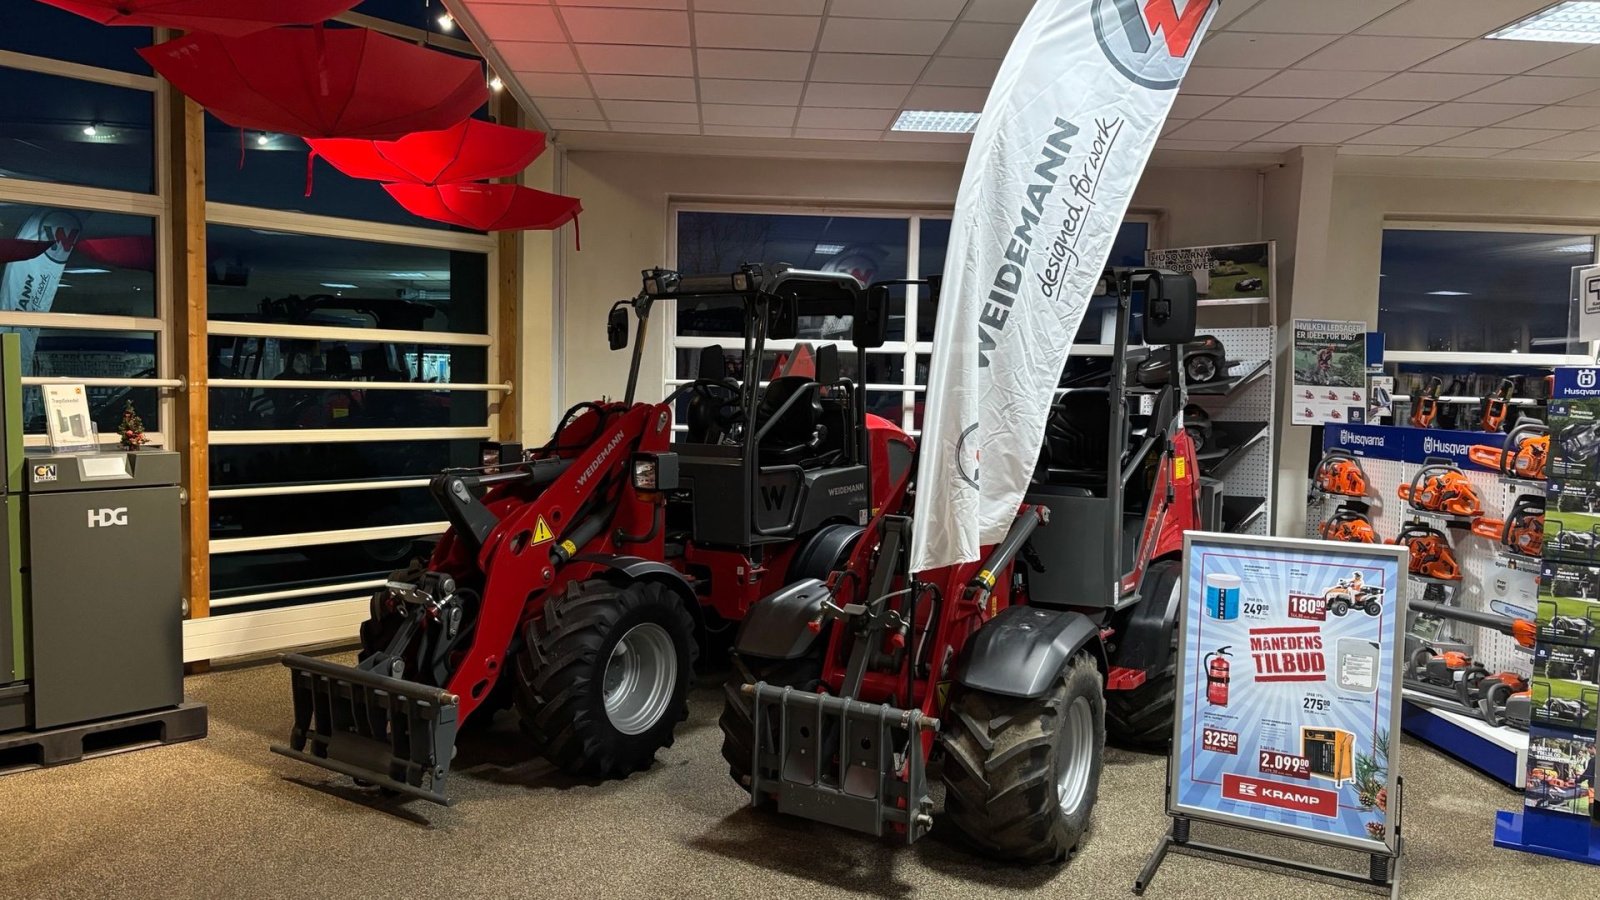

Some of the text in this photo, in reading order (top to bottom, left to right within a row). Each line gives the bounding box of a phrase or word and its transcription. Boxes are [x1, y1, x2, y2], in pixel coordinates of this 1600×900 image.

[1040, 115, 1120, 299] designed for work
[977, 116, 1081, 369] WEIDEMANN
[1151, 251, 1212, 263] HUSQVARNA
[1296, 322, 1361, 332] HVILKEN LEDSAGER
[1296, 331, 1306, 339] ER
[1307, 331, 1325, 339] IDEEL
[1326, 332, 1340, 340] FOR
[1564, 388, 1600, 397] Husqvar
[1347, 433, 1384, 447] Husqvarna
[1433, 439, 1469, 456] Husqvar
[577, 430, 624, 486] WEIDEMANN
[828, 482, 864, 497] WEIDEMANN
[87, 507, 128, 528] HDG
[1250, 636, 1322, 651] MÅNEDENS
[1252, 652, 1326, 674] TILBUD
[1262, 788, 1320, 805] KRAMP
